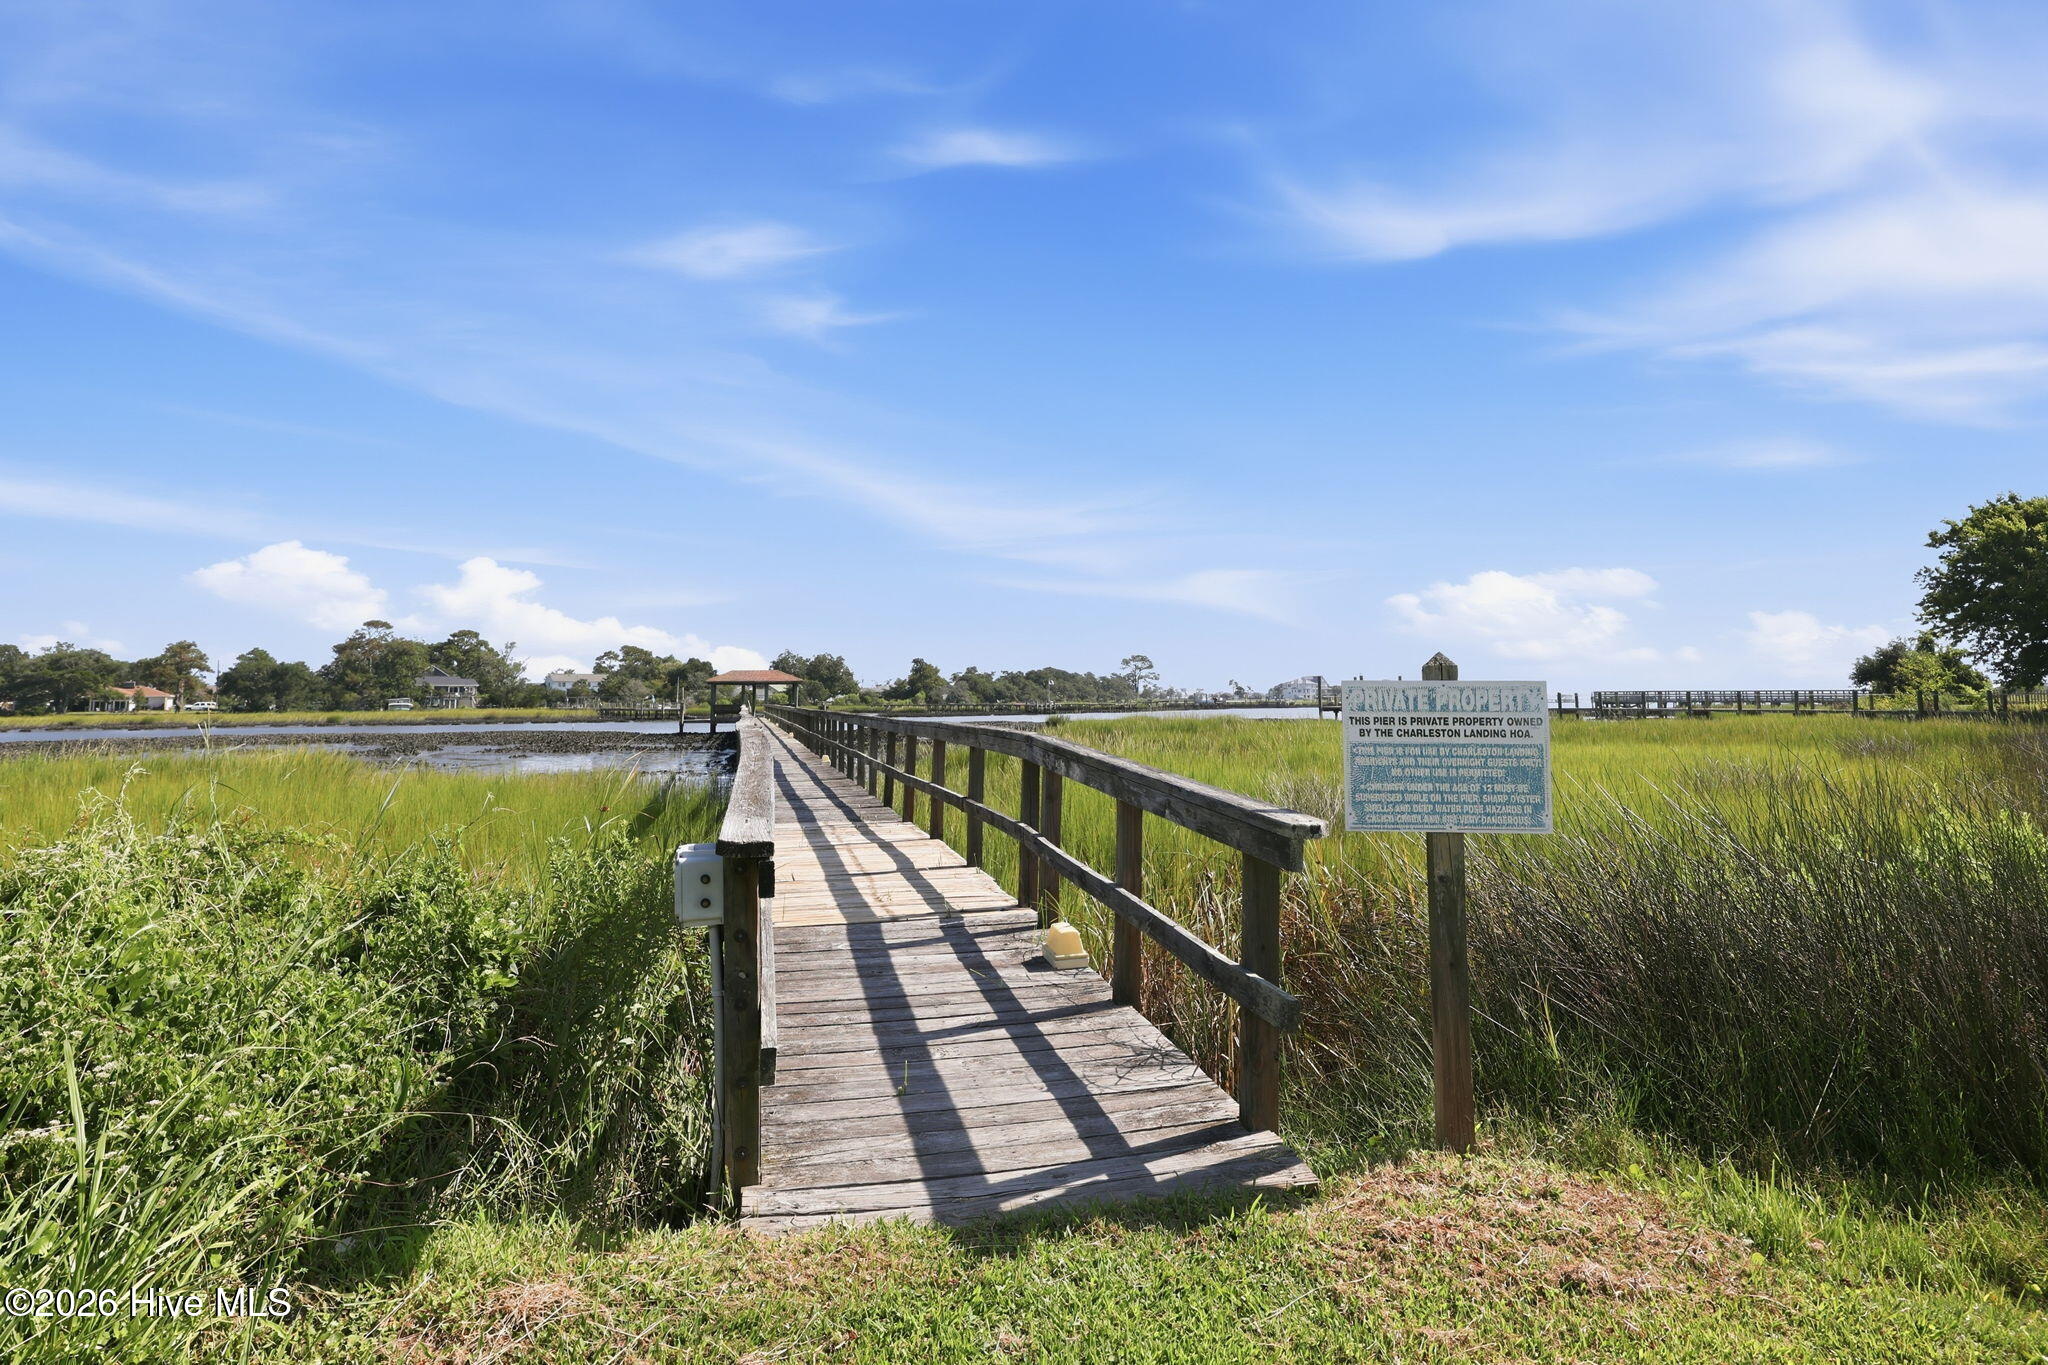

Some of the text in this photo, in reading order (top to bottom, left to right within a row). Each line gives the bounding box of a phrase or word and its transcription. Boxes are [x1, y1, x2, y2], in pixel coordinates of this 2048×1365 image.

[1349, 716, 1543, 727] THIS PIER IS PRIVATE PROPERTY OWNED
[1359, 728, 1534, 739] BY THE CHARLESTON LANDING HOA.
